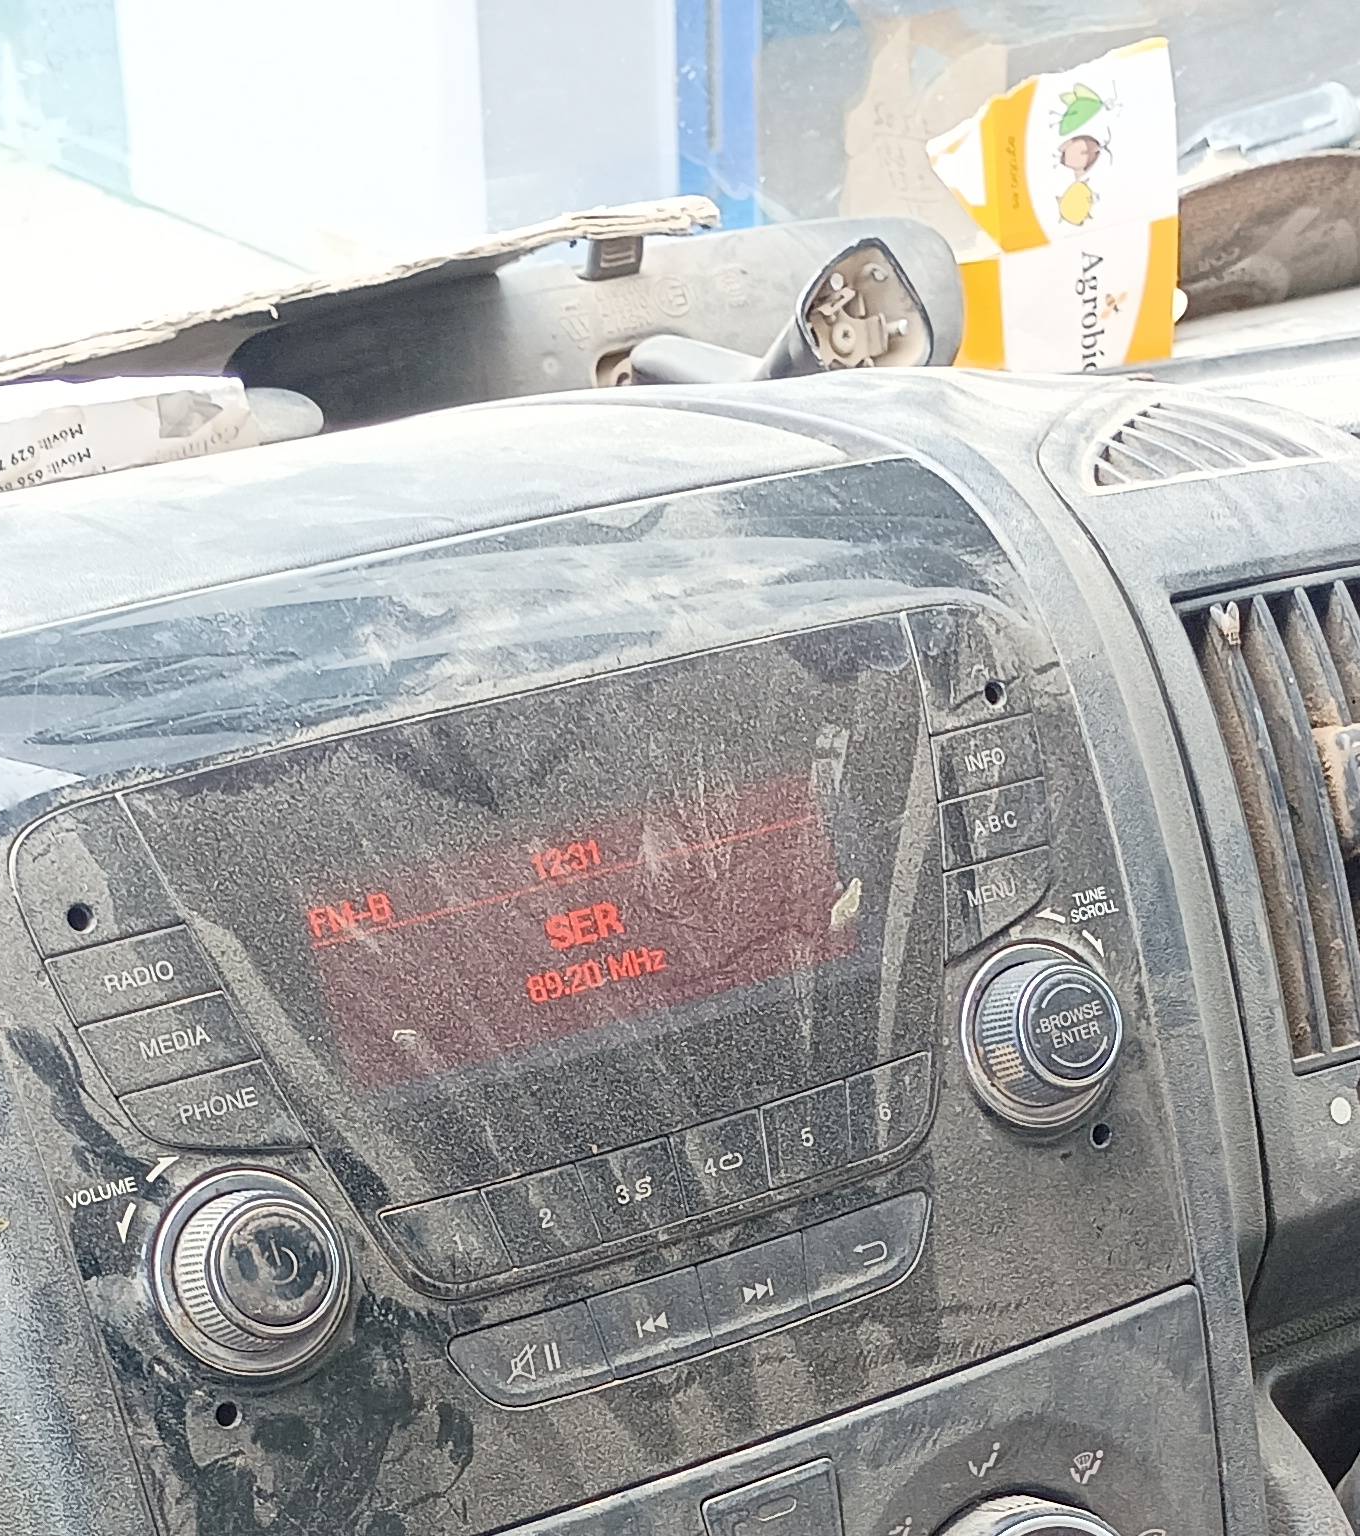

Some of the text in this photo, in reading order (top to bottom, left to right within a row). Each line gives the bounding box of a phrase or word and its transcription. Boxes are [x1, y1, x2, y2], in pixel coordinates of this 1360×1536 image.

[10, 445, 36, 466] 629
[964, 747, 1007, 774] INFO
[530, 839, 603, 882] 12:31
[966, 879, 1018, 908] MENU
[1071, 886, 1108, 909] TUNE
[544, 901, 628, 952] SER
[1069, 900, 1120, 924] SCROLL
[103, 959, 175, 994] RADIO
[526, 946, 668, 1005] 89.20 MHz
[1039, 1000, 1104, 1035] BROWSE
[138, 1023, 212, 1063] MEDIA
[1051, 1020, 1102, 1050] ENTER
[178, 1086, 260, 1126] PHONE
[878, 1102, 893, 1123] 6
[800, 1127, 815, 1149] 5
[703, 1157, 718, 1179] 4
[65, 1176, 139, 1210] VOLUME
[615, 1183, 631, 1205] 3
[538, 1207, 556, 1229] 2
